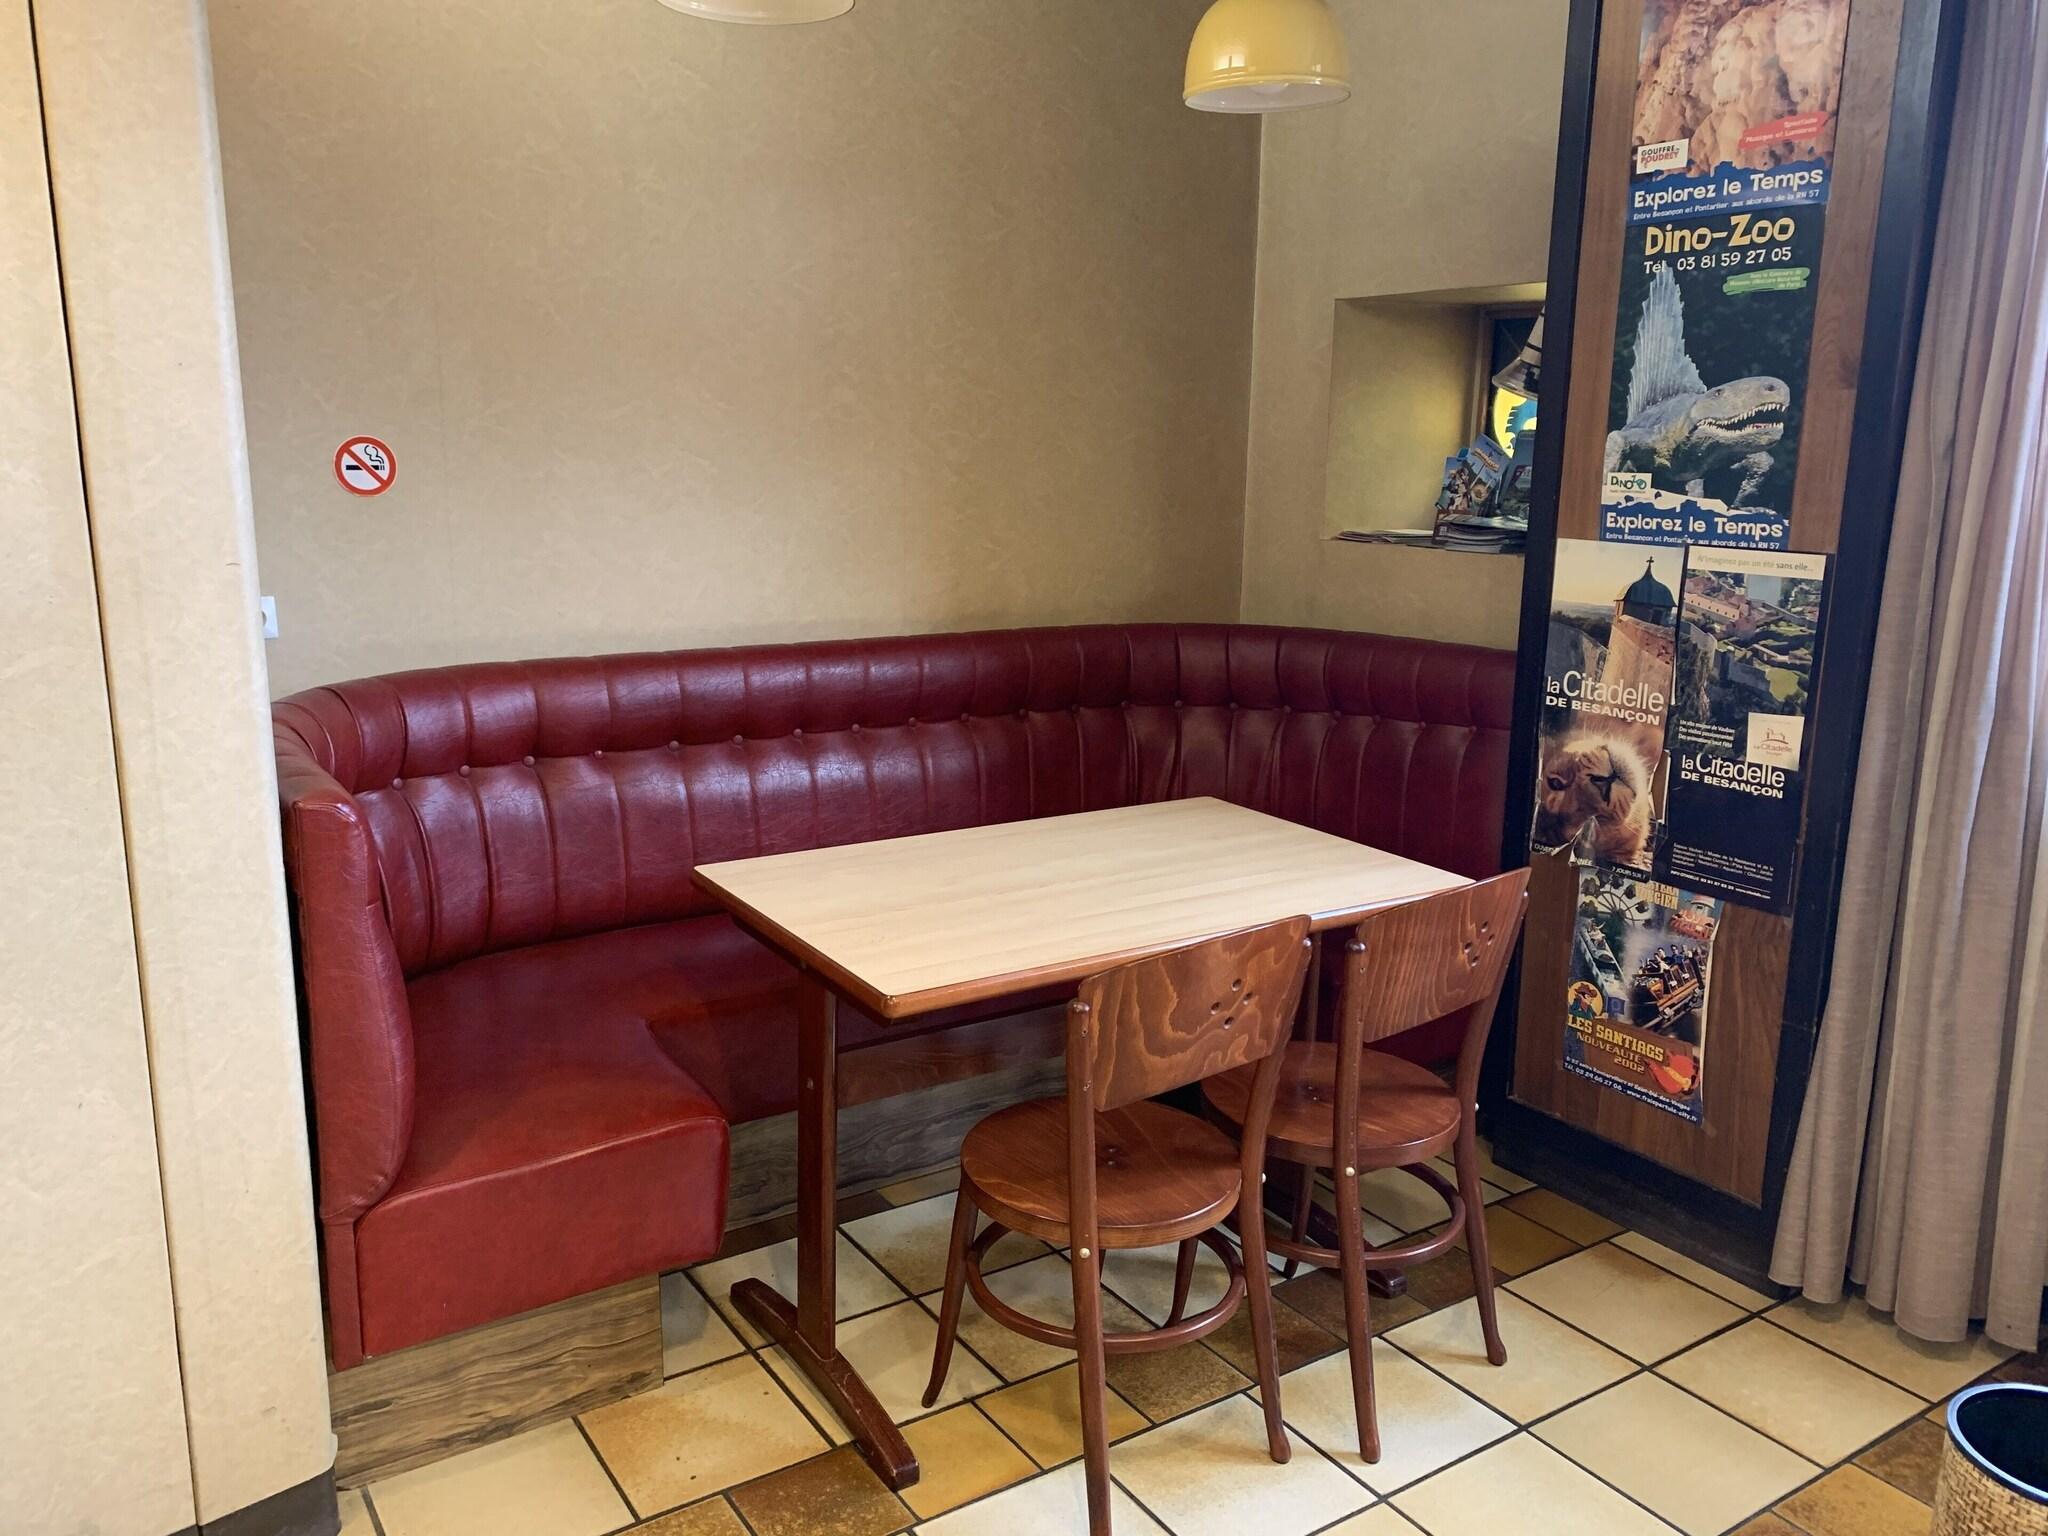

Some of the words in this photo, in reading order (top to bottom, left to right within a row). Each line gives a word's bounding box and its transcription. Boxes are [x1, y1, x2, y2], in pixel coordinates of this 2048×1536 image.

[1640, 151, 1679, 169] POUDREY
[1641, 145, 1676, 157] GOUFFRE
[1634, 186, 1717, 211] Explorez
[1723, 178, 1742, 196] le
[1750, 169, 1824, 192] Temps
[1808, 189, 1820, 198] 57
[1644, 213, 1796, 256] Dino-Zoo
[1677, 256, 1696, 271] 03
[1700, 254, 1716, 269] 81
[1721, 251, 1741, 266] 59
[1745, 249, 1766, 265] 27
[1771, 246, 1792, 261] 05
[1606, 512, 1683, 533] Explorez
[1688, 516, 1706, 533] le
[1714, 517, 1783, 541] Temps
[1769, 542, 1780, 550] 57
[1776, 561, 1793, 569] sans
[1547, 676, 1560, 694] la
[1563, 670, 1664, 712] Citadelle
[1545, 695, 1567, 708] DE
[1571, 700, 1660, 726] BESANÇON
[1681, 754, 1694, 769] la
[1696, 752, 1785, 788] Citadelle
[1681, 770, 1700, 782] DE
[1704, 775, 1783, 799] BESANÇON
[1568, 1013, 1593, 1034] LES
[1596, 1024, 1664, 1062] SANTIAGS
[1614, 1055, 1645, 1074] 2002
